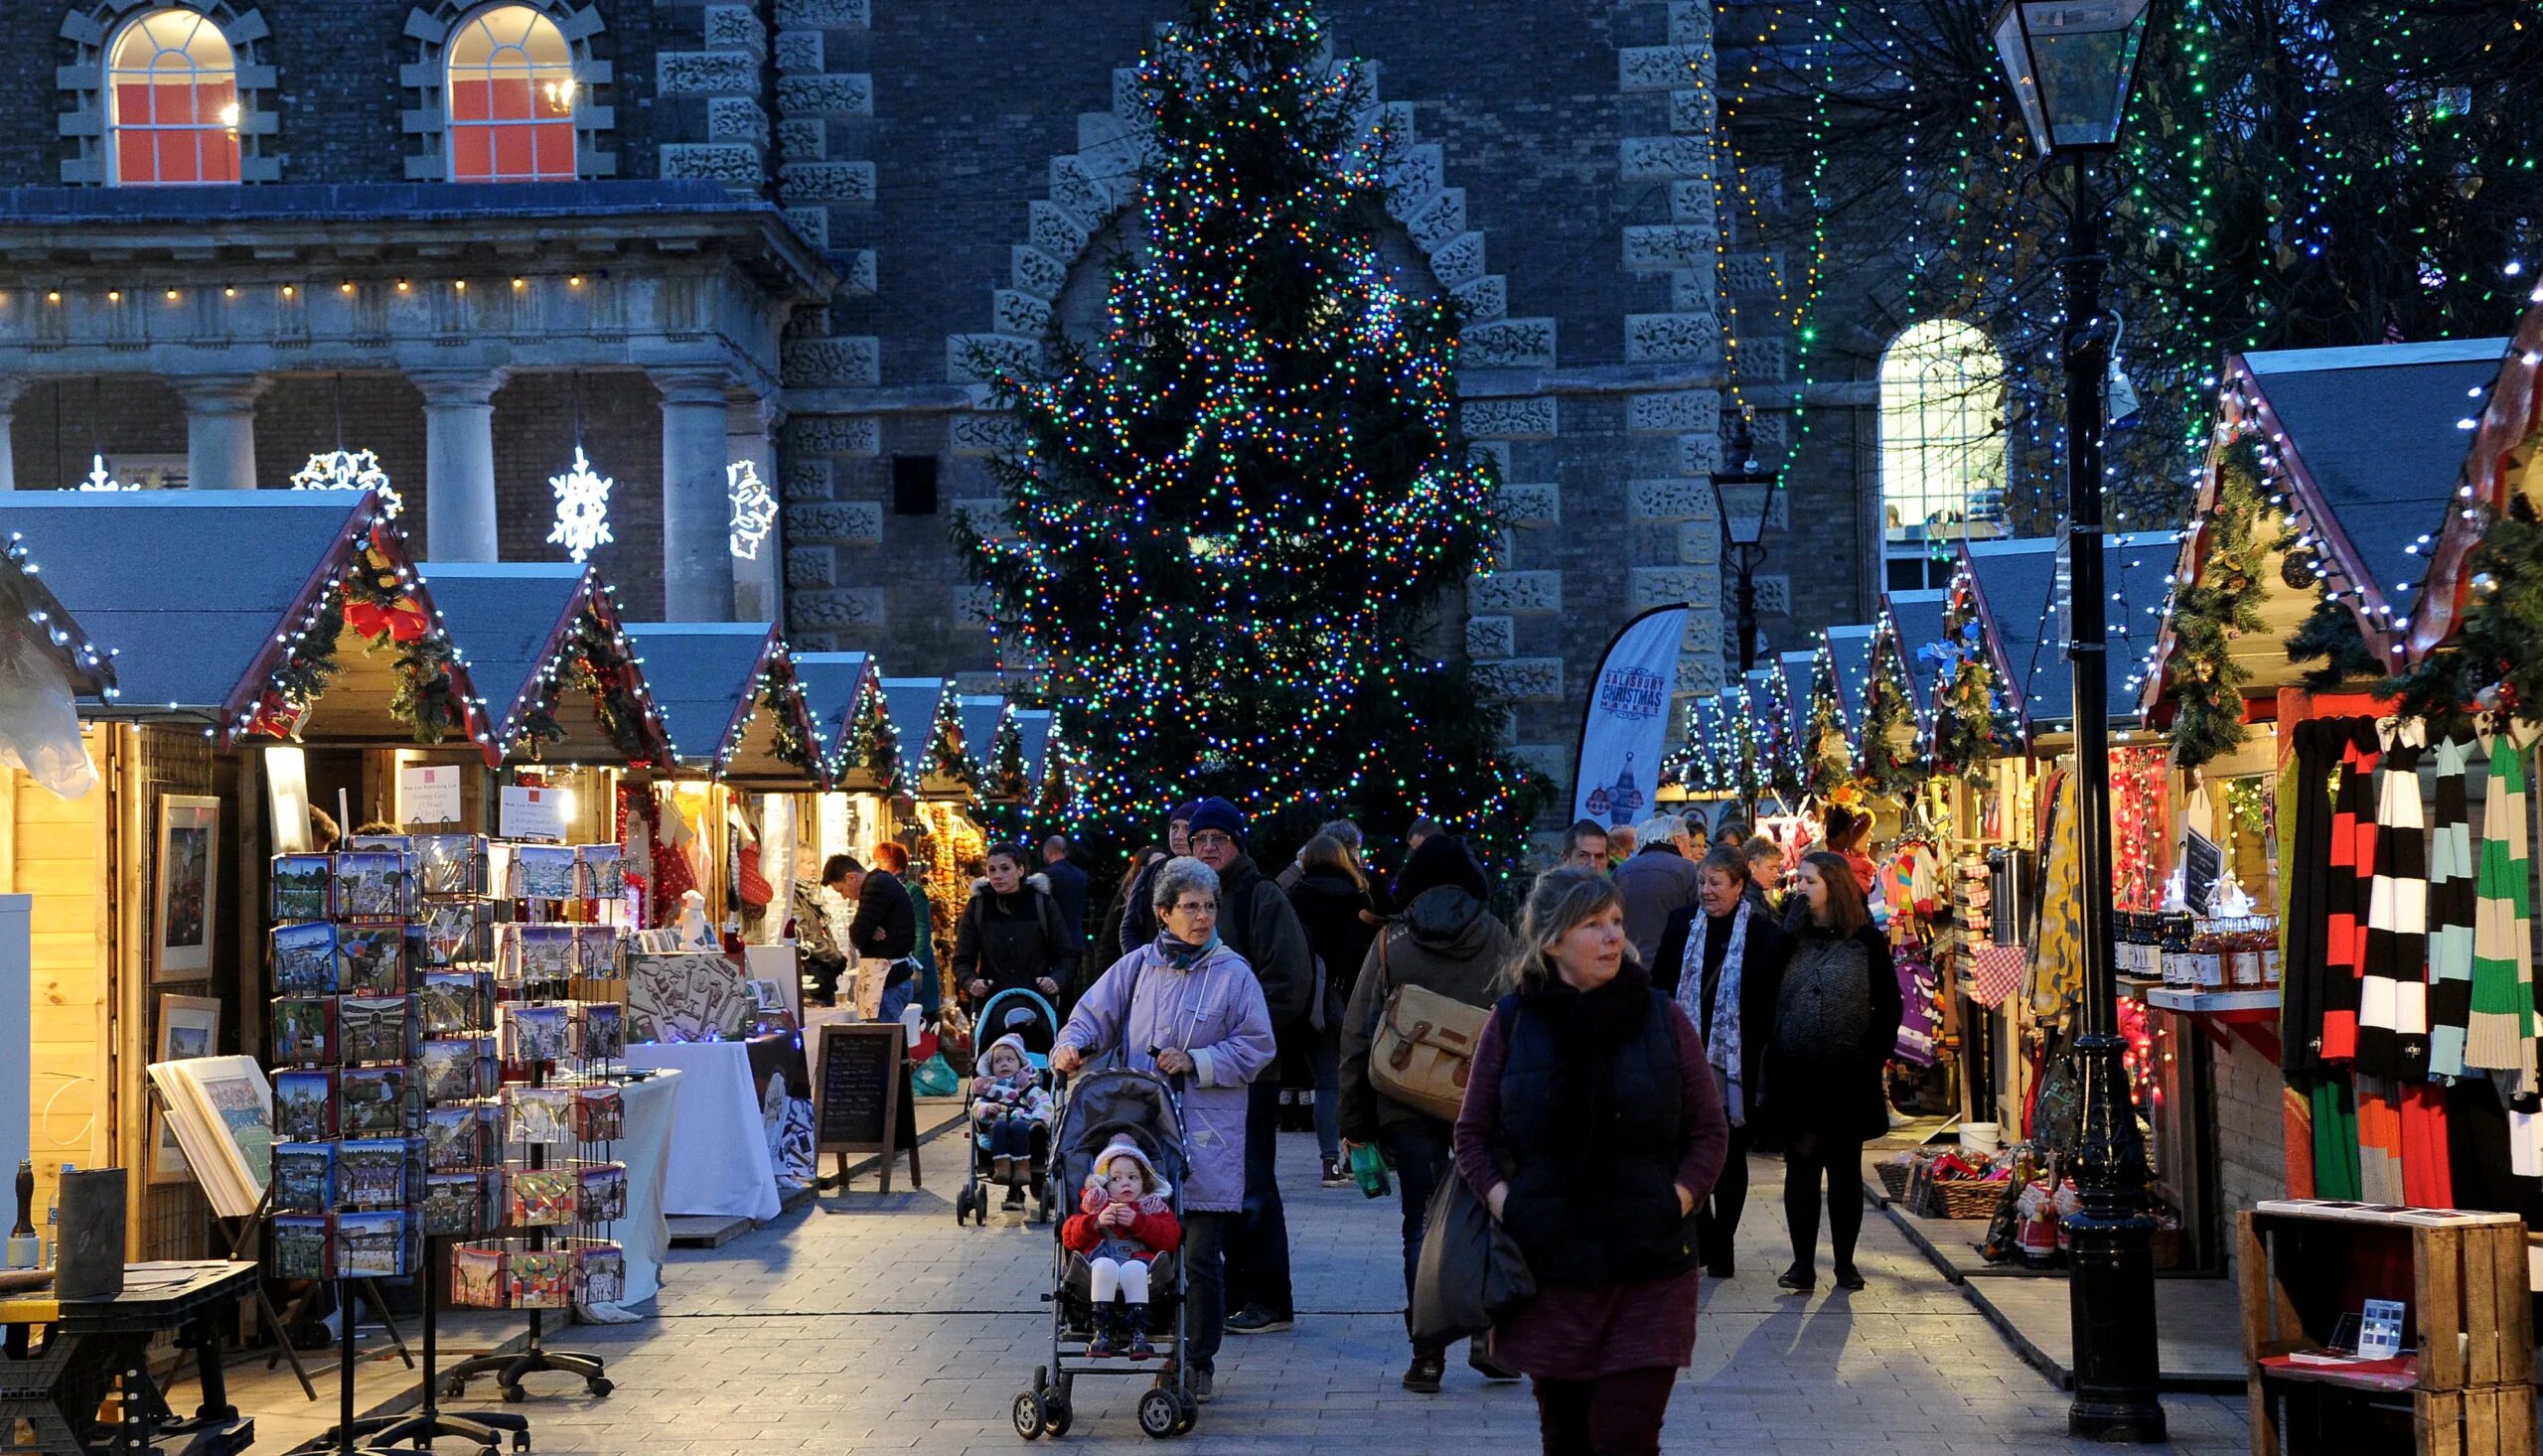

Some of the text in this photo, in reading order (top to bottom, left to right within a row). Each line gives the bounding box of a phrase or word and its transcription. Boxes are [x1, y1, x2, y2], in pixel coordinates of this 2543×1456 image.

[1604, 672, 1665, 690] SALISBURY
[1602, 684, 1662, 707] CHRISTMAS
[1600, 700, 1659, 714] MARKET
